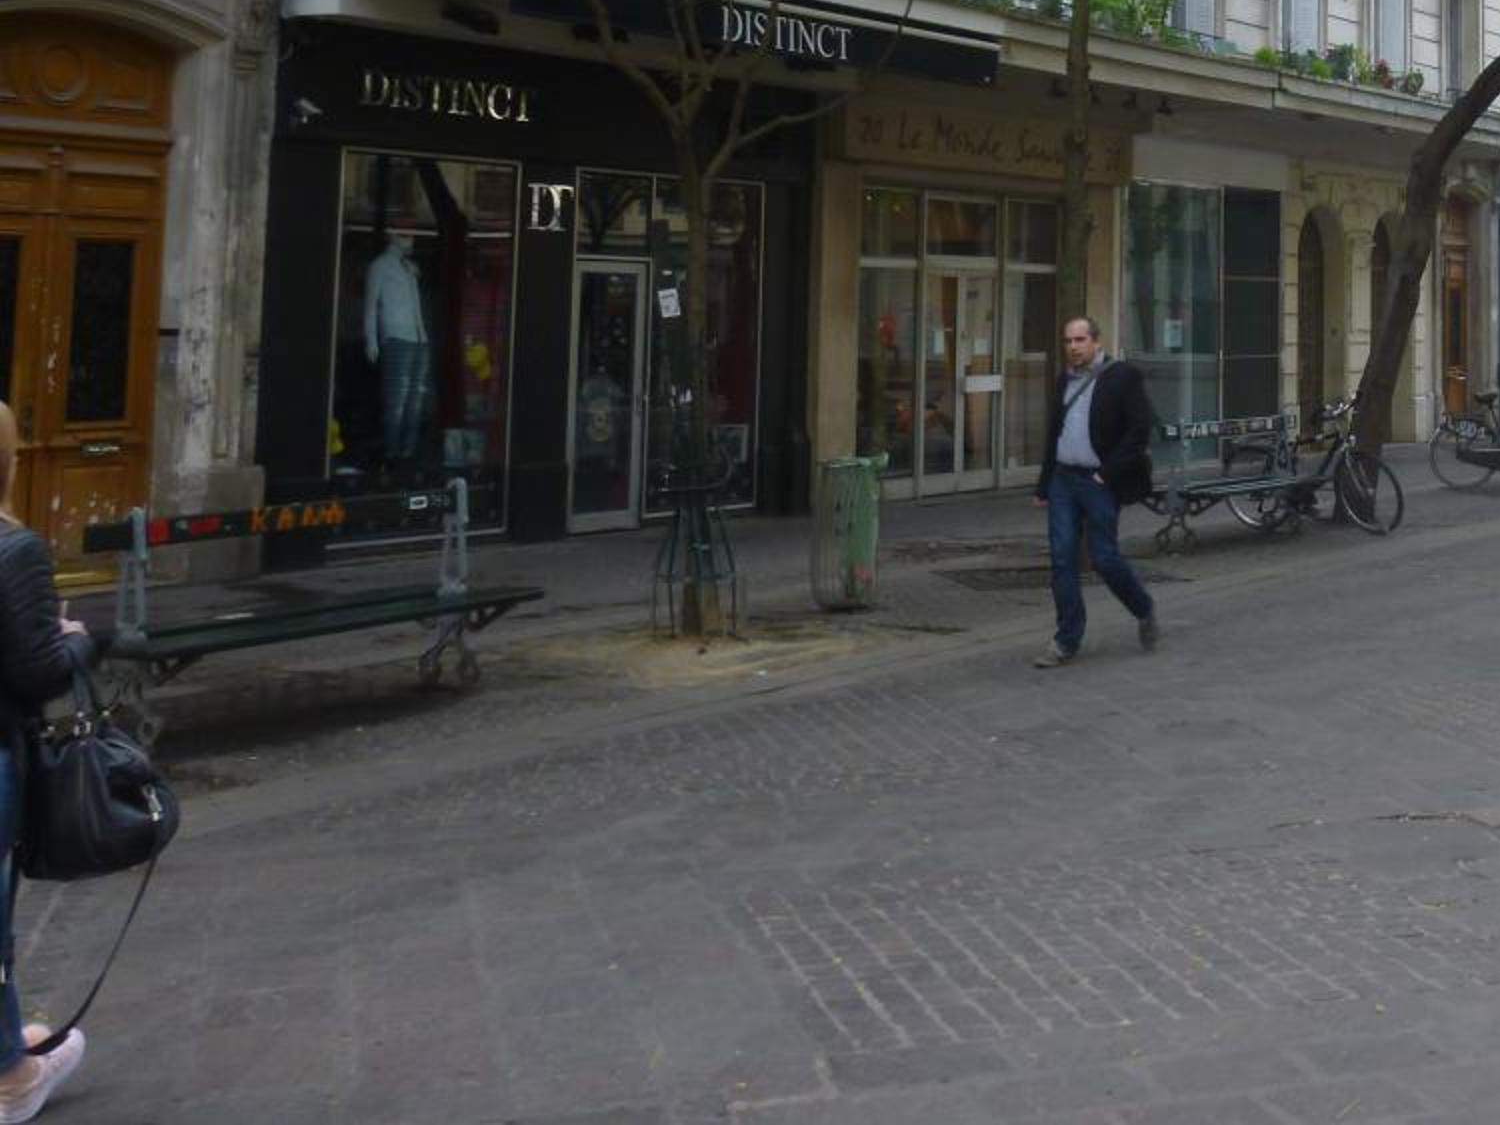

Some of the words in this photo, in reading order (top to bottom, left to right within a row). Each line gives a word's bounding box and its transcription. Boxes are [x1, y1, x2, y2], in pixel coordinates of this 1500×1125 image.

[722, 6, 850, 60] DISTINCT
[360, 69, 534, 122] DISTINCT
[896, 108, 924, 152] Le
[934, 113, 1006, 163] Monde
